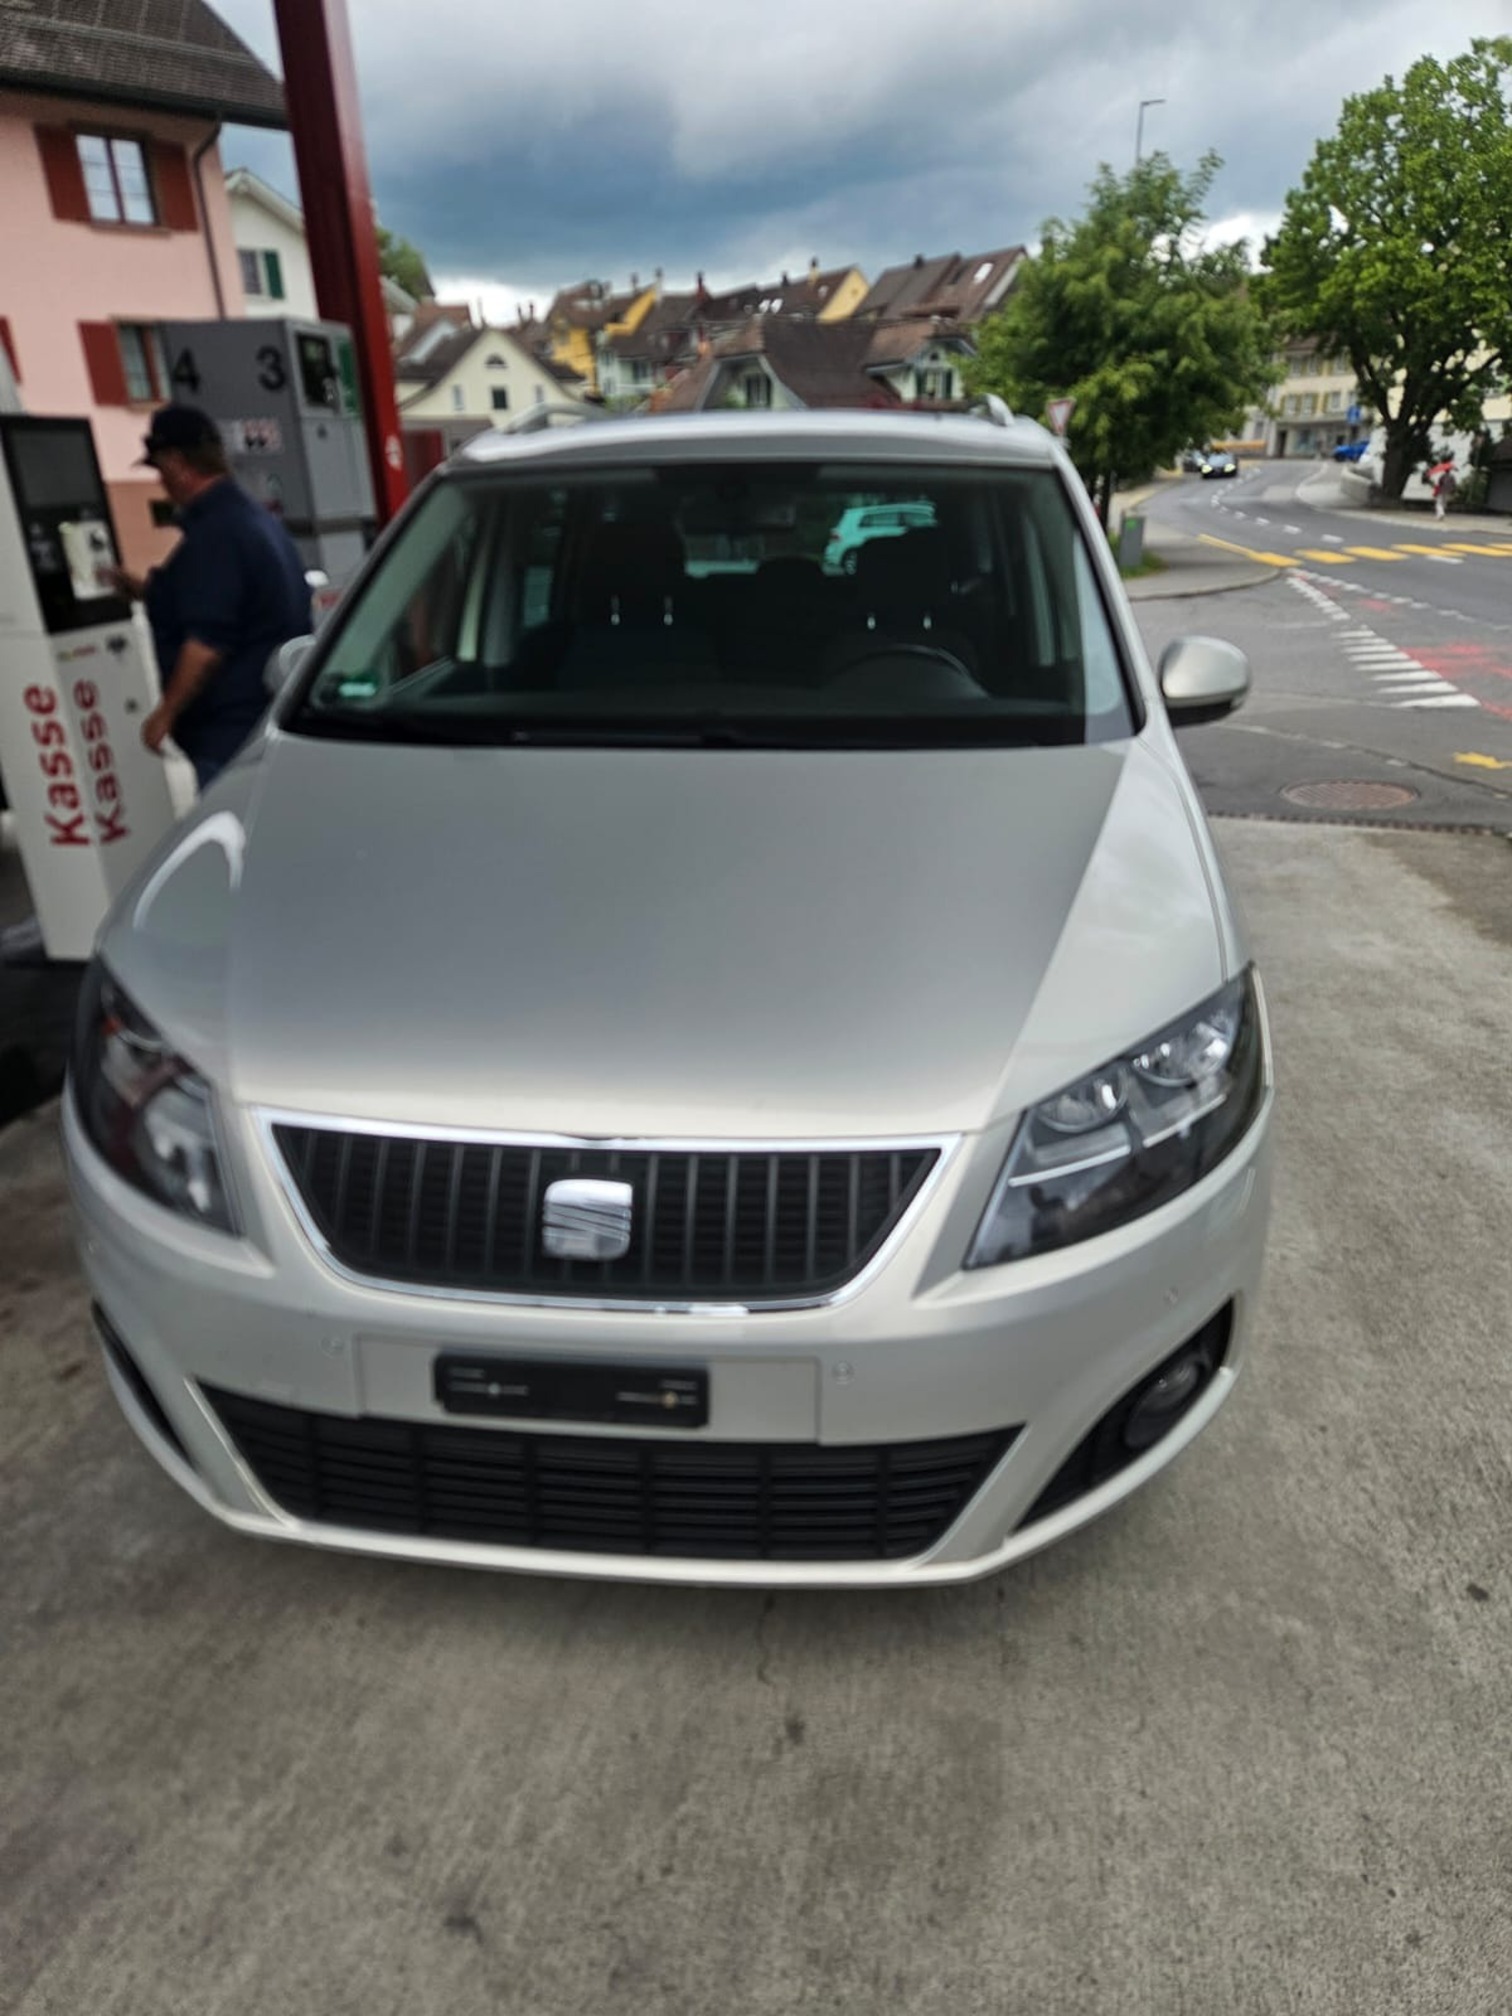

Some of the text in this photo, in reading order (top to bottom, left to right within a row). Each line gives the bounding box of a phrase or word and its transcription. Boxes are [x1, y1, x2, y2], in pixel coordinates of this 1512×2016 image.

[172, 347, 201, 394] 4
[256, 345, 286, 391] 3
[23, 684, 91, 846] Kasse
[73, 679, 129, 844] Kasse
